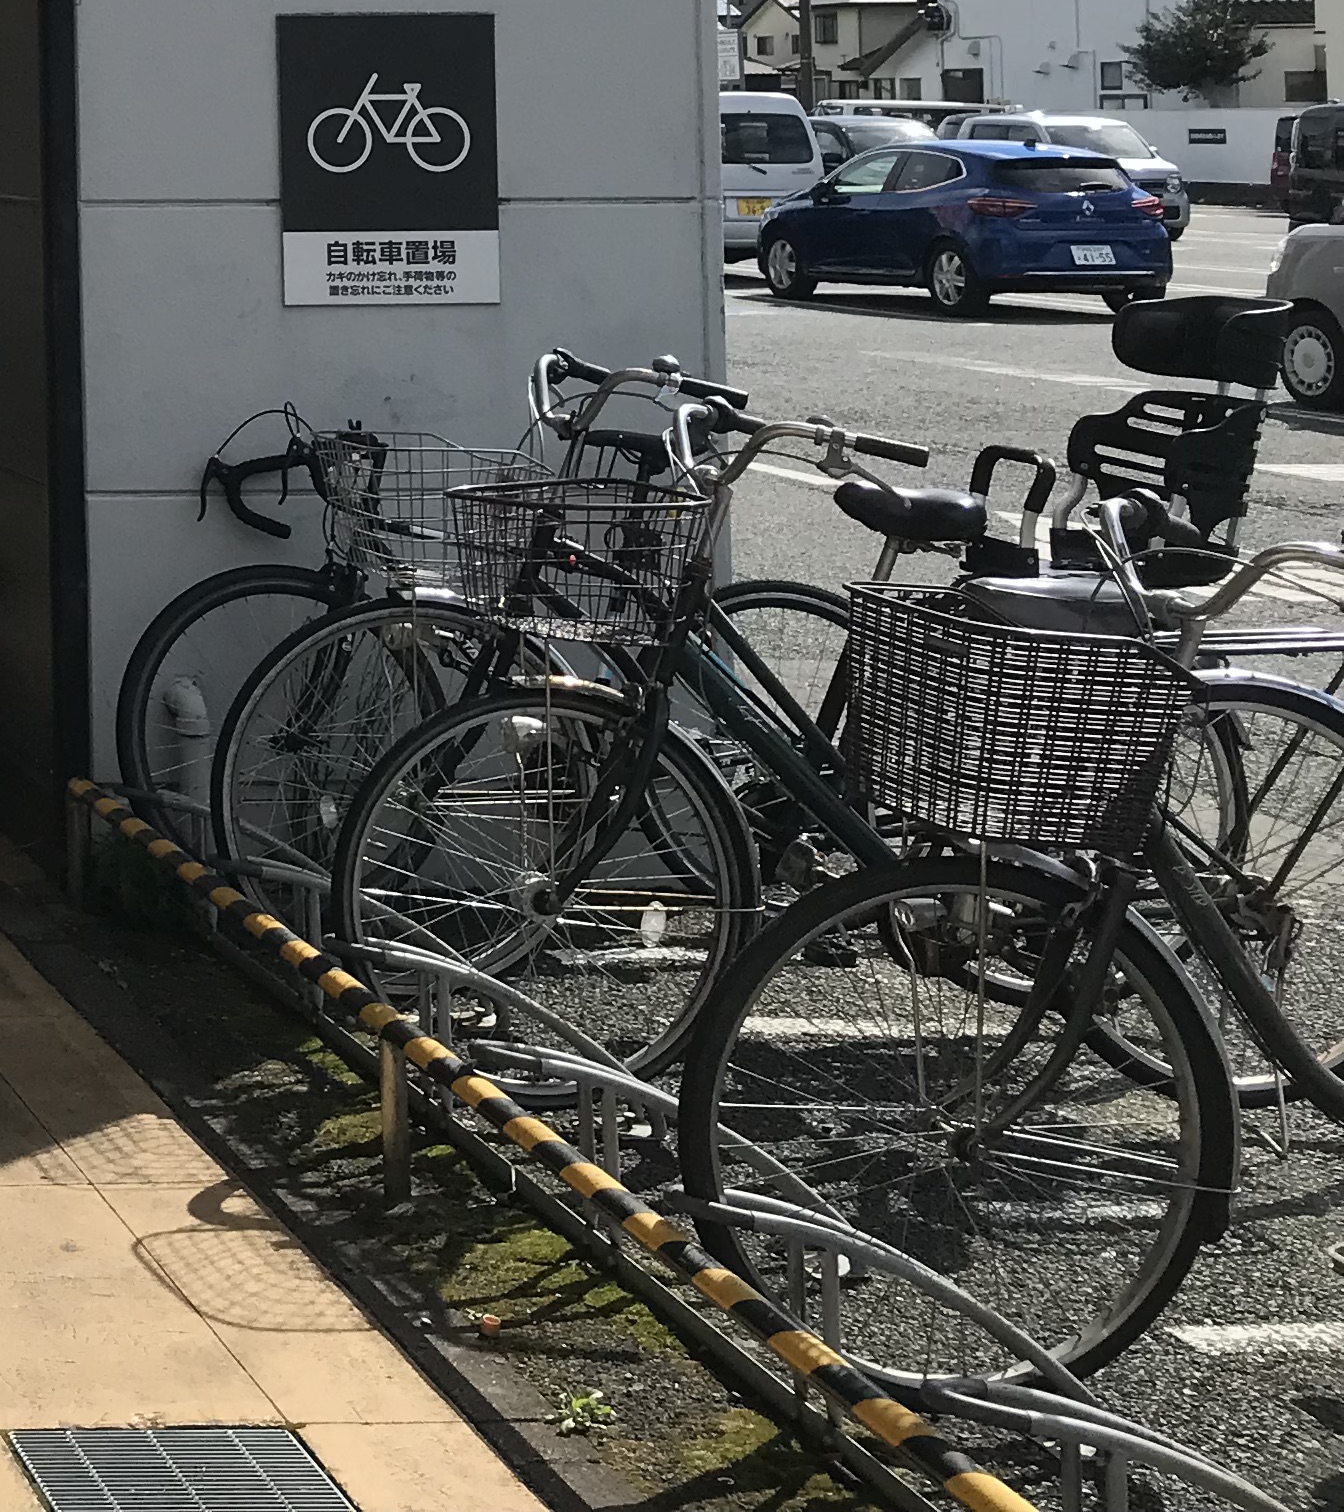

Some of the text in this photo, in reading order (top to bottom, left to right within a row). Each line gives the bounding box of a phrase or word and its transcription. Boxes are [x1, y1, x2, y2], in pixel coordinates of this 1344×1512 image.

[327, 240, 457, 266] 自転車置場
[326, 270, 457, 283] カギのかけ忘れ、手荷物等の
[329, 284, 454, 296] 置き忘れにご注意ください
